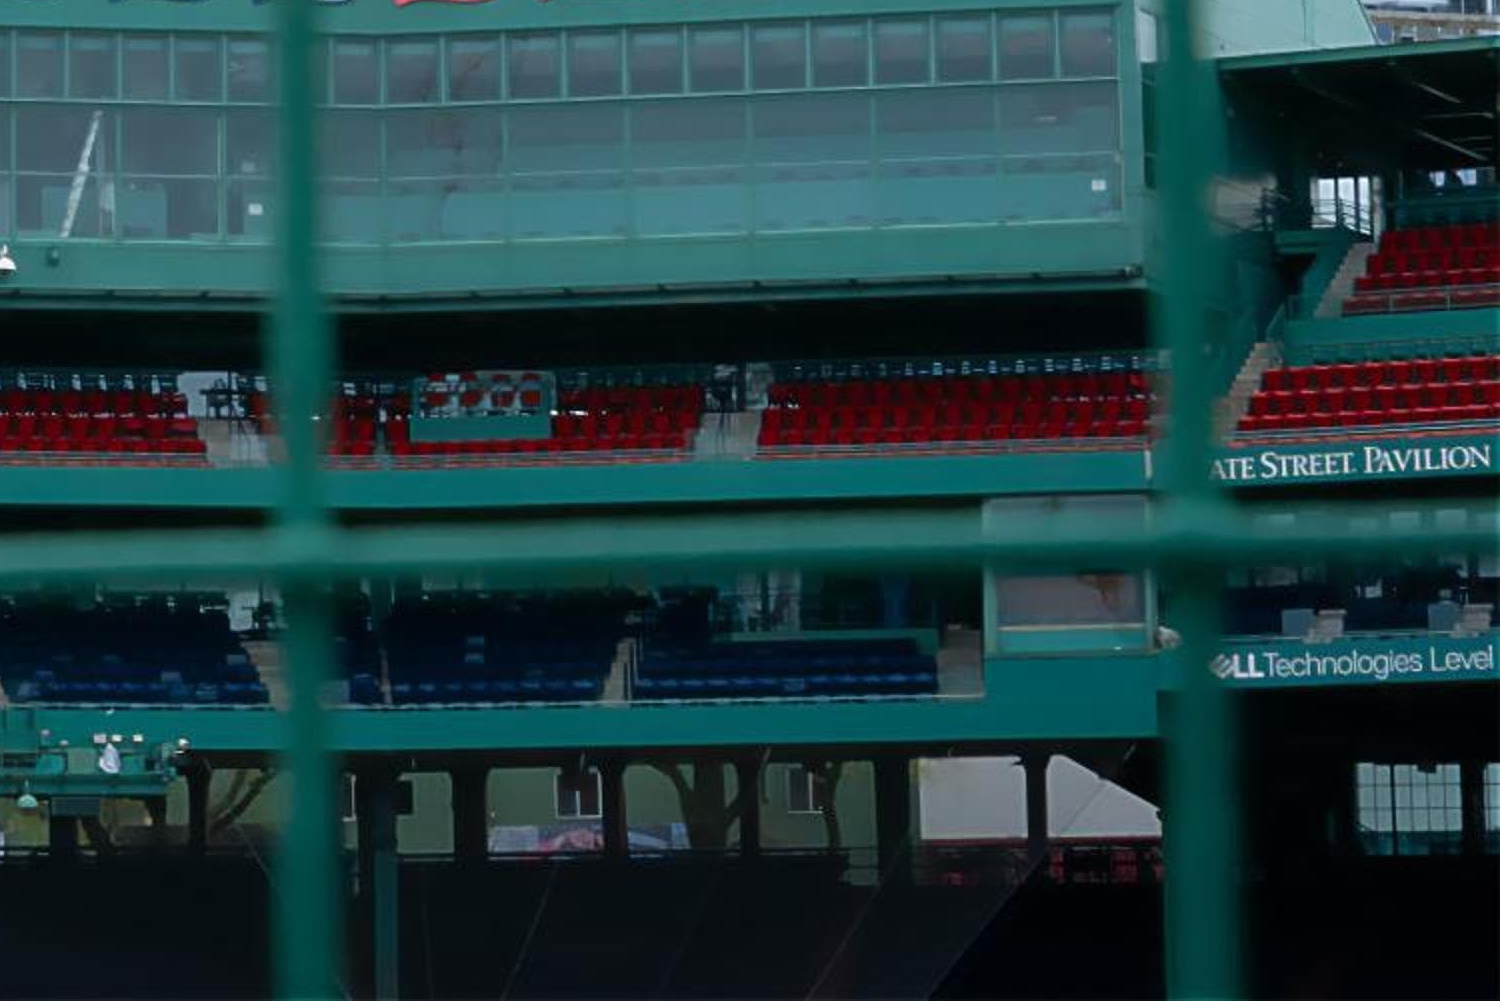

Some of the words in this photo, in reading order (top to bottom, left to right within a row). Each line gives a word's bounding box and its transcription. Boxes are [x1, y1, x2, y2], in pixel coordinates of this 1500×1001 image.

[1210, 457, 1256, 480] ATE
[1260, 452, 1354, 479] STREET
[1363, 445, 1492, 474] PAVILION
[1209, 653, 1264, 679] ELL
[1264, 650, 1423, 680] Technologies
[1429, 644, 1494, 673] Level
